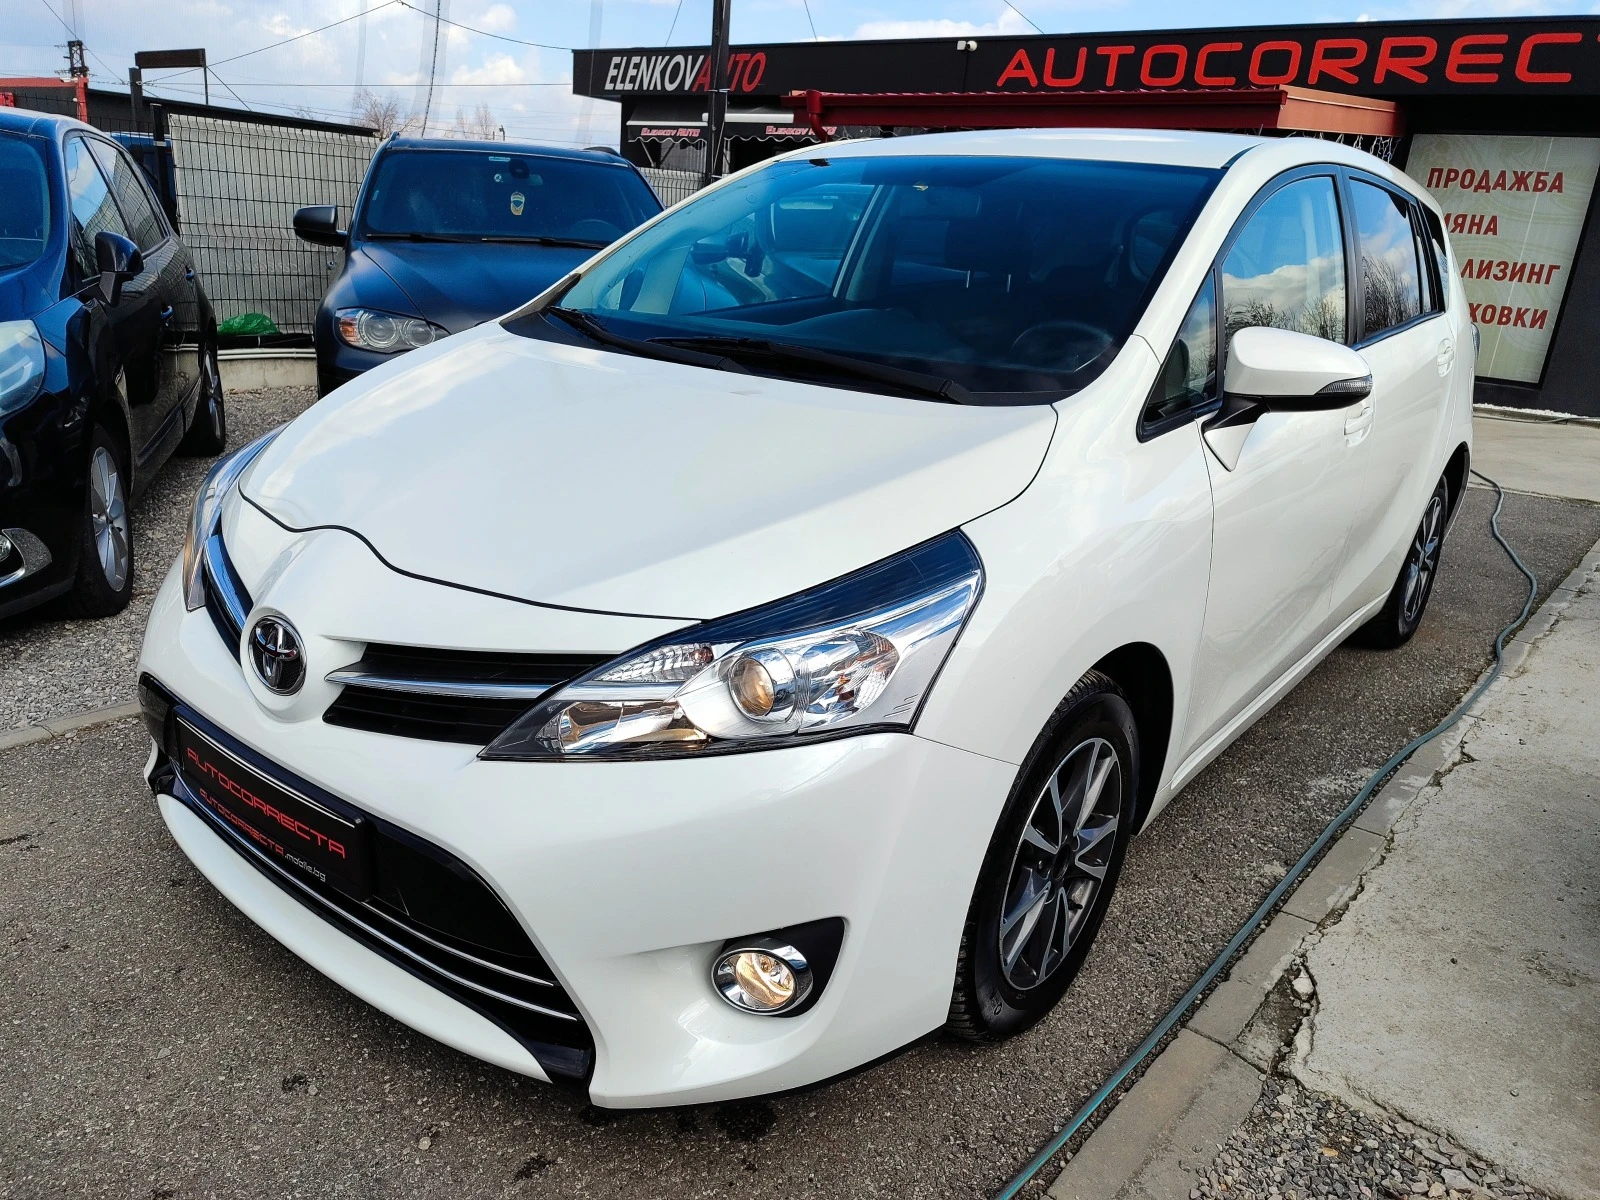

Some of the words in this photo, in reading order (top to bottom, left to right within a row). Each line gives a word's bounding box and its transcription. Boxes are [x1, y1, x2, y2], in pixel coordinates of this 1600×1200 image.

[604, 52, 766, 92] ELENKOVATO
[997, 33, 1600, 88] AUTOCORREC
[1426, 167, 1564, 194] ПРОДАЖБА
[1460, 258, 1561, 285] ЛИЗИНГ
[187, 747, 346, 859] AUTOCORRECTA
